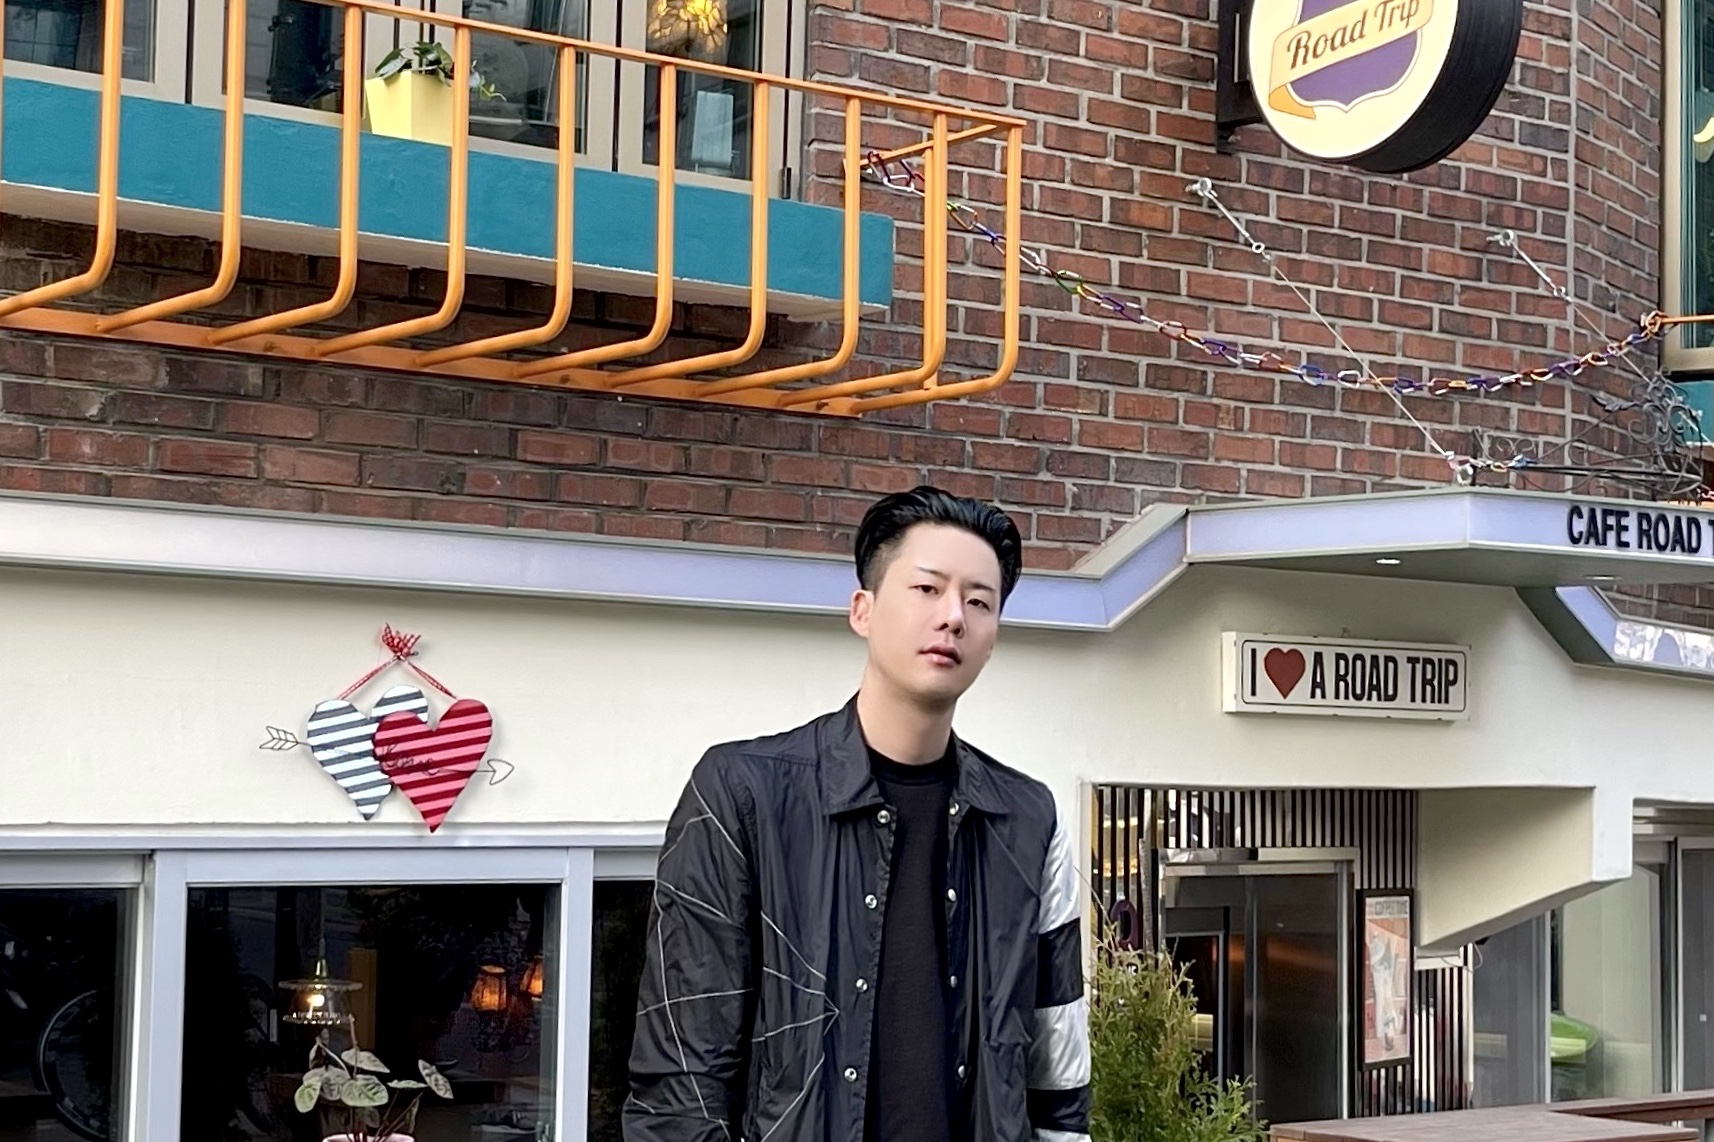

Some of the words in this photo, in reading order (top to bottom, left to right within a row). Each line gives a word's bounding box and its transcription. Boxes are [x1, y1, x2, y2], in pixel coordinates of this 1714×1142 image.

[1287, 9, 1368, 70] Road
[1374, 0, 1420, 32] Trip
[1567, 505, 1630, 548] CAFE
[1637, 512, 1702, 553] ROAD
[1250, 647, 1257, 697] I
[1310, 651, 1327, 699] A
[1334, 652, 1399, 702] ROAD
[1406, 656, 1458, 704] TRIP
